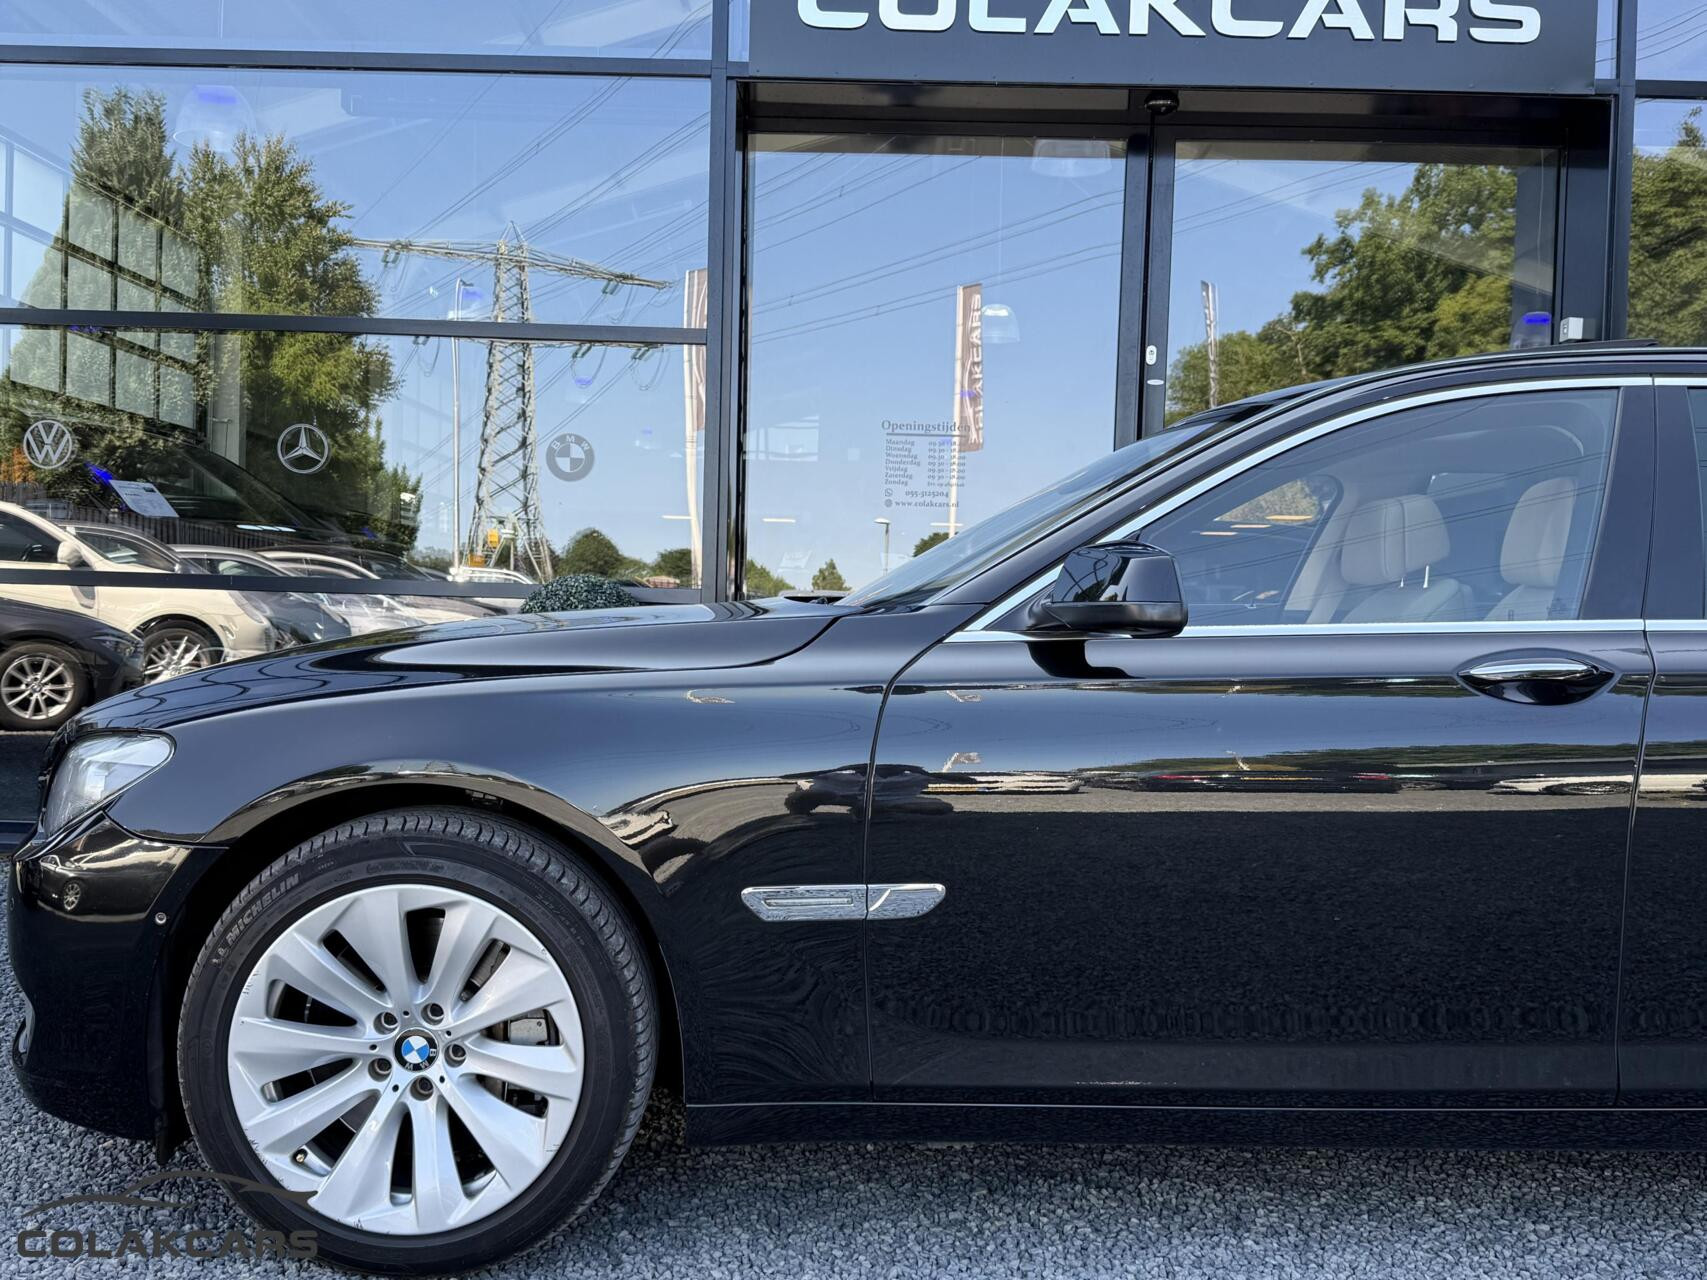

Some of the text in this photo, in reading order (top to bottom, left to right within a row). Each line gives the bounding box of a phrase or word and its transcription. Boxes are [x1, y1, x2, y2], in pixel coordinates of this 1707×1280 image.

[881, 420, 971, 433] Openingstijden
[551, 434, 590, 450] BMW
[885, 439, 915, 447] Maandag
[885, 445, 912, 453] Dinsdag
[885, 452, 918, 460] Woensdag
[885, 459, 920, 467] Donderdag
[885, 465, 908, 473] Vrijdag
[884, 472, 913, 480] Zaterdag
[884, 479, 908, 487] Zondag
[895, 499, 959, 508] www.colakcars.nl
[226, 873, 299, 946] MICHELIN
[404, 1048, 437, 1071] BMW
